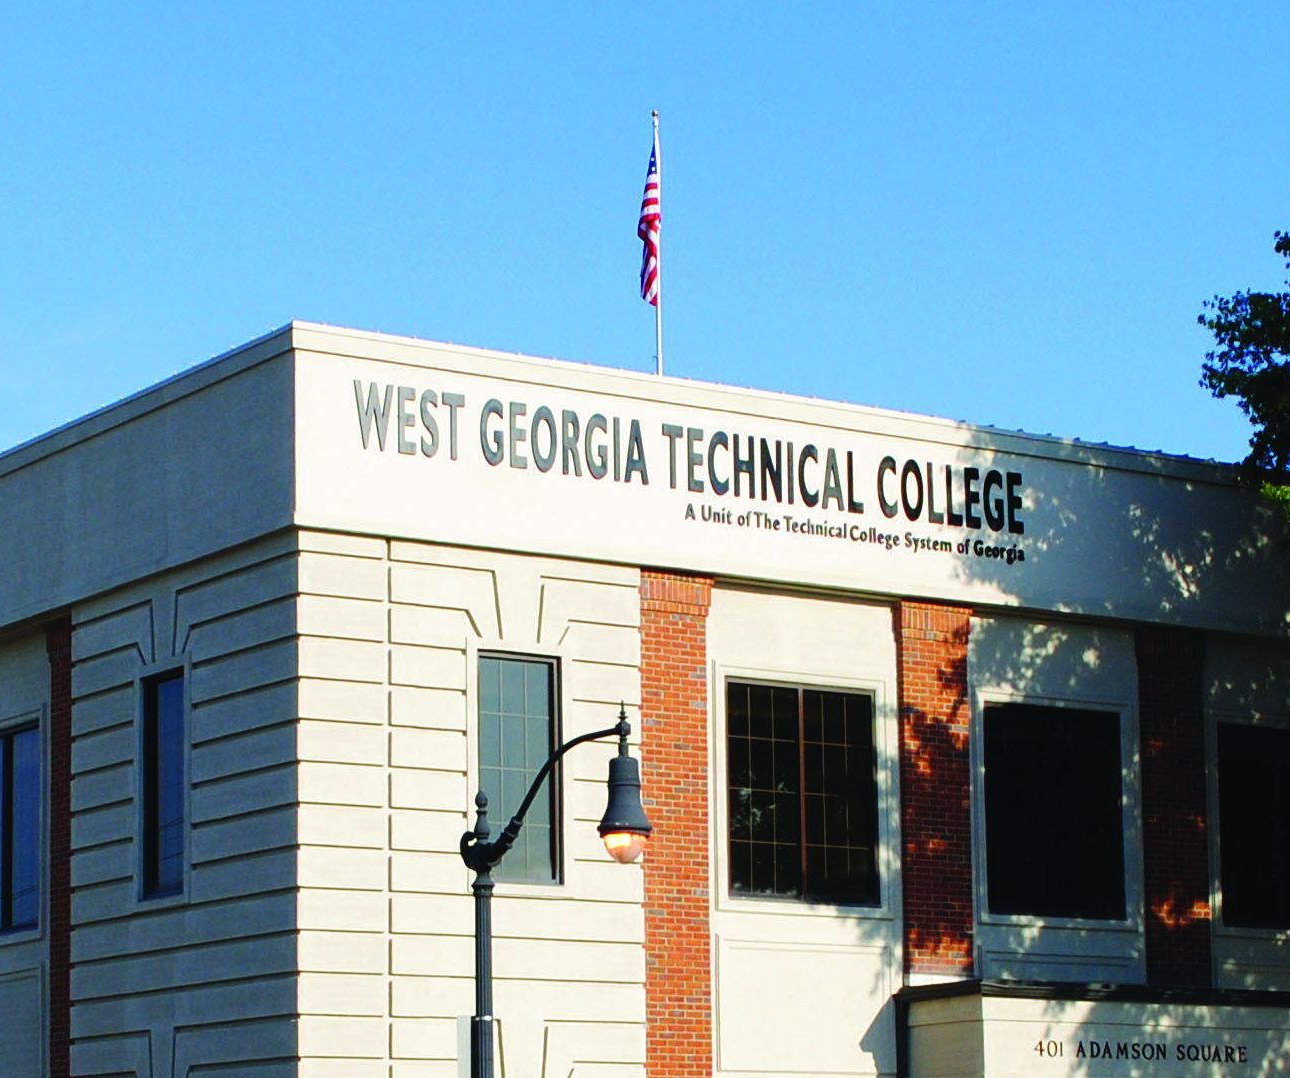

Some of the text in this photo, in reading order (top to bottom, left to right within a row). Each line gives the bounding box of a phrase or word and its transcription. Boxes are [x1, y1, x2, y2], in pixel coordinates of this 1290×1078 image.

[353, 379, 1024, 534] WEST GEORGIA TECHNICAL COLLEGE
[685, 503, 1025, 565] A Unit of The Technical College System of Georgia
[1034, 1041, 1247, 1064] 401 ADAMSON SQUARE
